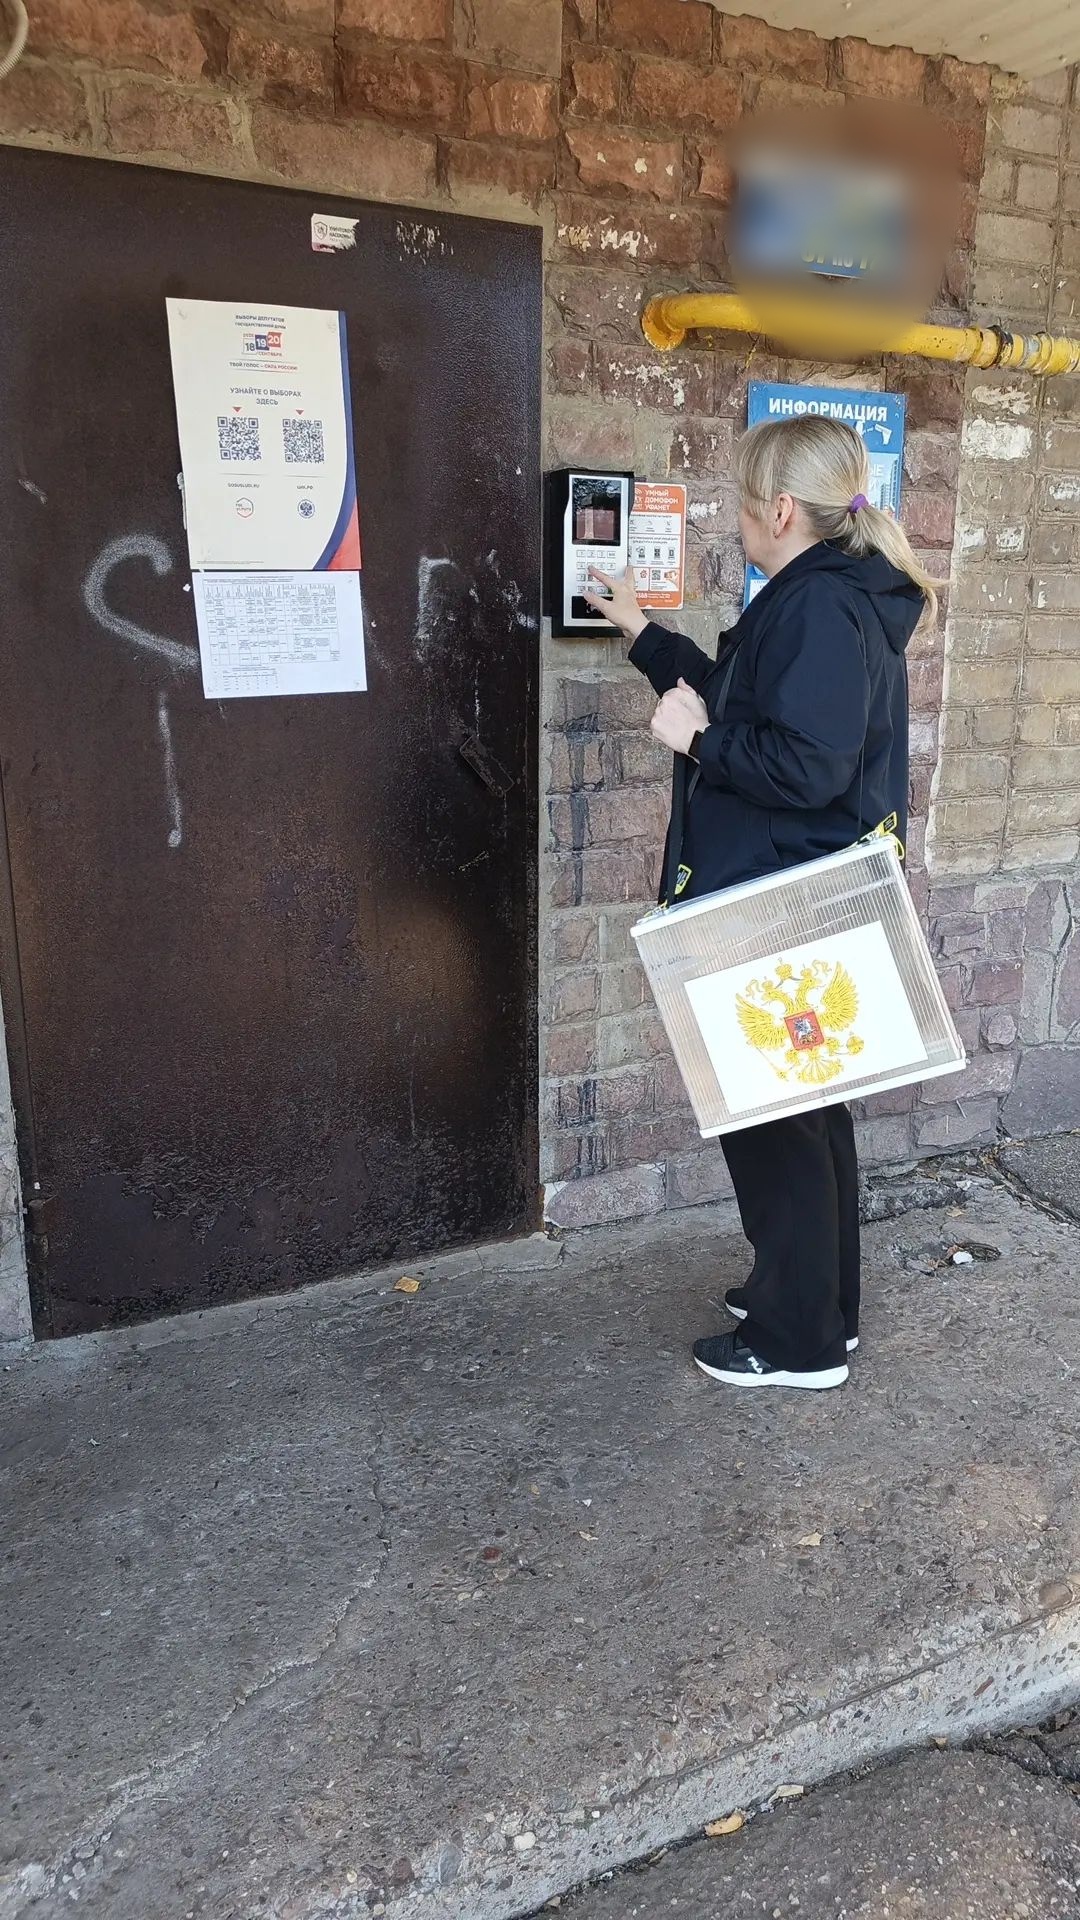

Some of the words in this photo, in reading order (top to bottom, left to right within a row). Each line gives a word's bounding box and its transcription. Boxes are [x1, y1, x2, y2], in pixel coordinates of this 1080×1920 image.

[245, 342, 255, 351] 18
[256, 338, 267, 348] 19
[268, 335, 280, 345] 20
[230, 387, 262, 395] УЗНАЙТЕ
[269, 389, 302, 397] ВЫБОРАХ
[769, 397, 888, 423] ИНФОРМАЦИЯ
[645, 489, 669, 497] УМНЫЙ
[747, 1356, 763, 1374] FILA
